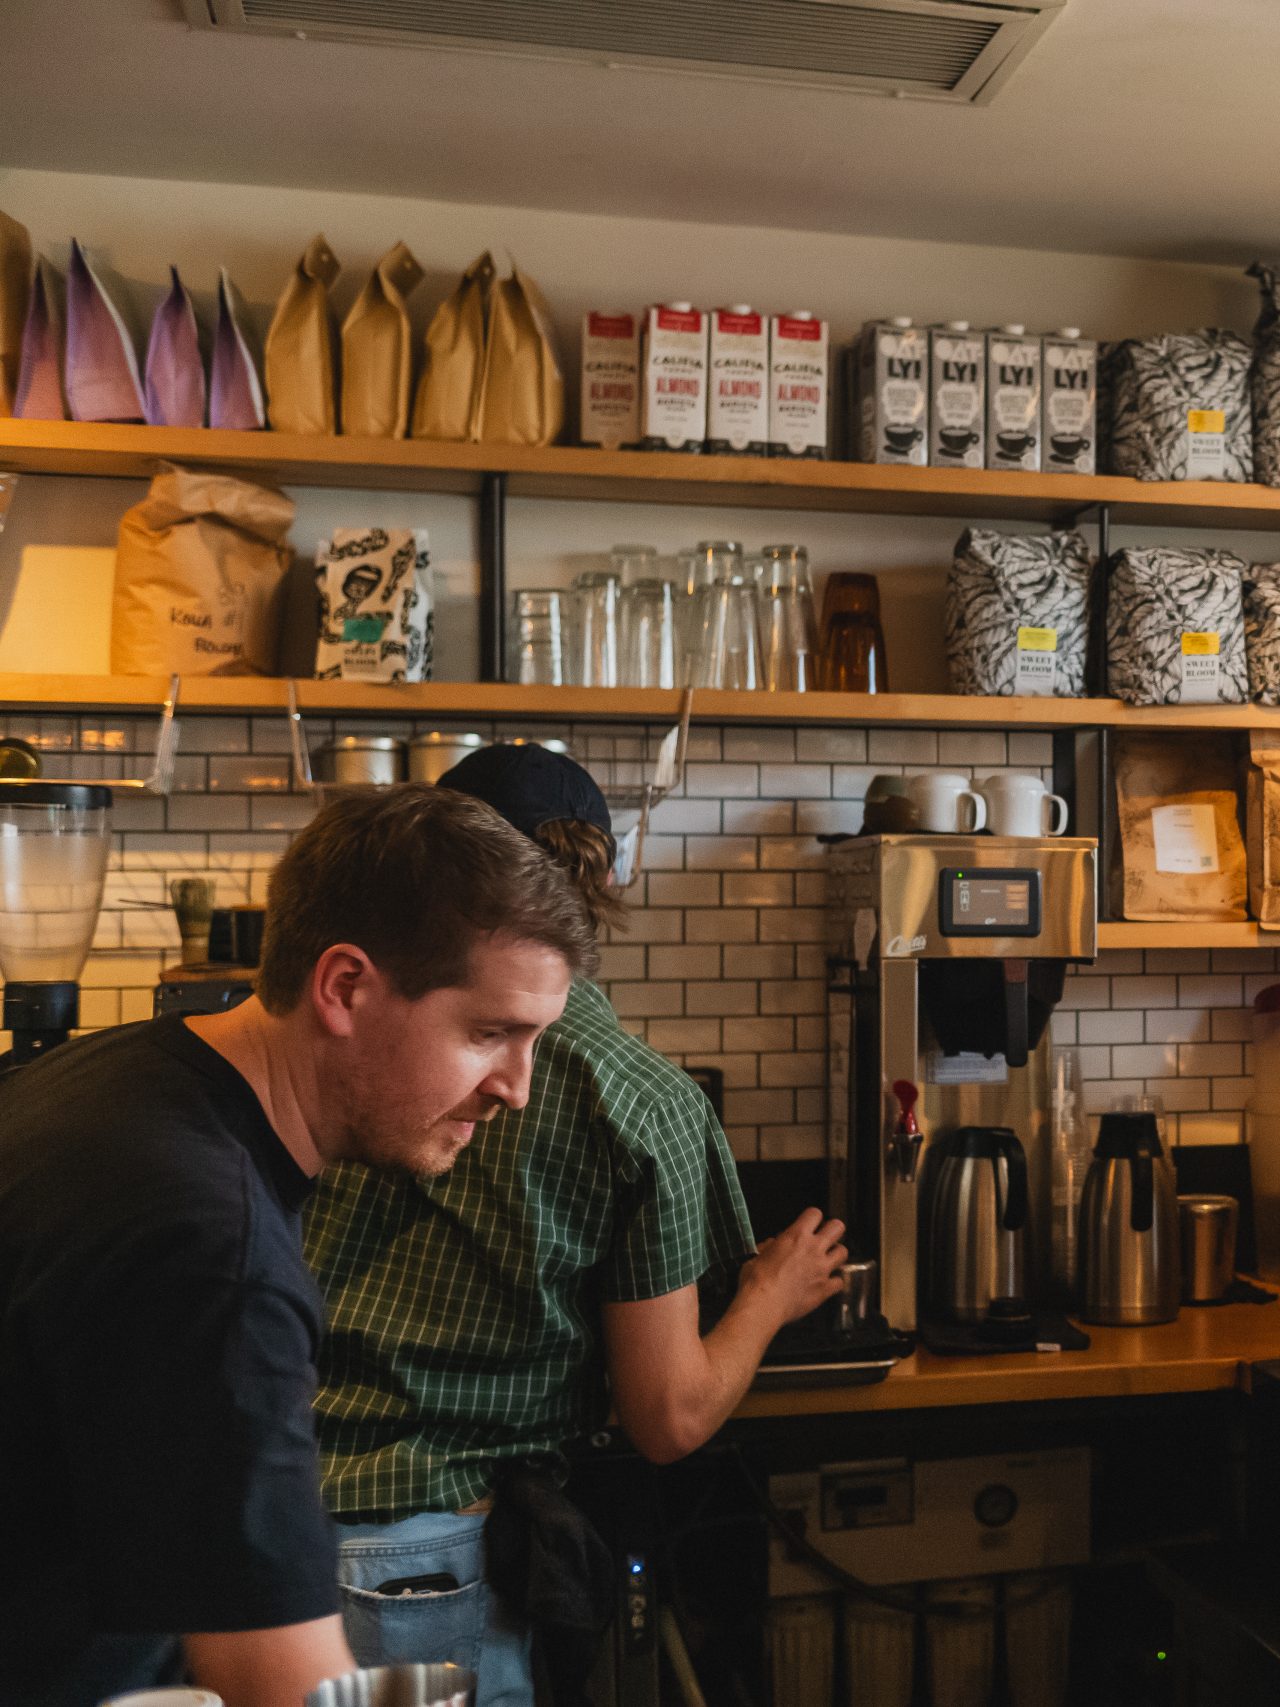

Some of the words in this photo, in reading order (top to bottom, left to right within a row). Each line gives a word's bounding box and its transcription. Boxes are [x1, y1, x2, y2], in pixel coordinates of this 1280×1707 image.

[887, 358, 921, 380] LY!
[943, 361, 977, 382] LY!
[1000, 366, 1034, 386] LY!
[1054, 369, 1088, 389] LY!
[656, 378, 699, 397] ALMOND
[719, 380, 761, 399] ALMOND
[778, 384, 819, 404] ALMOND
